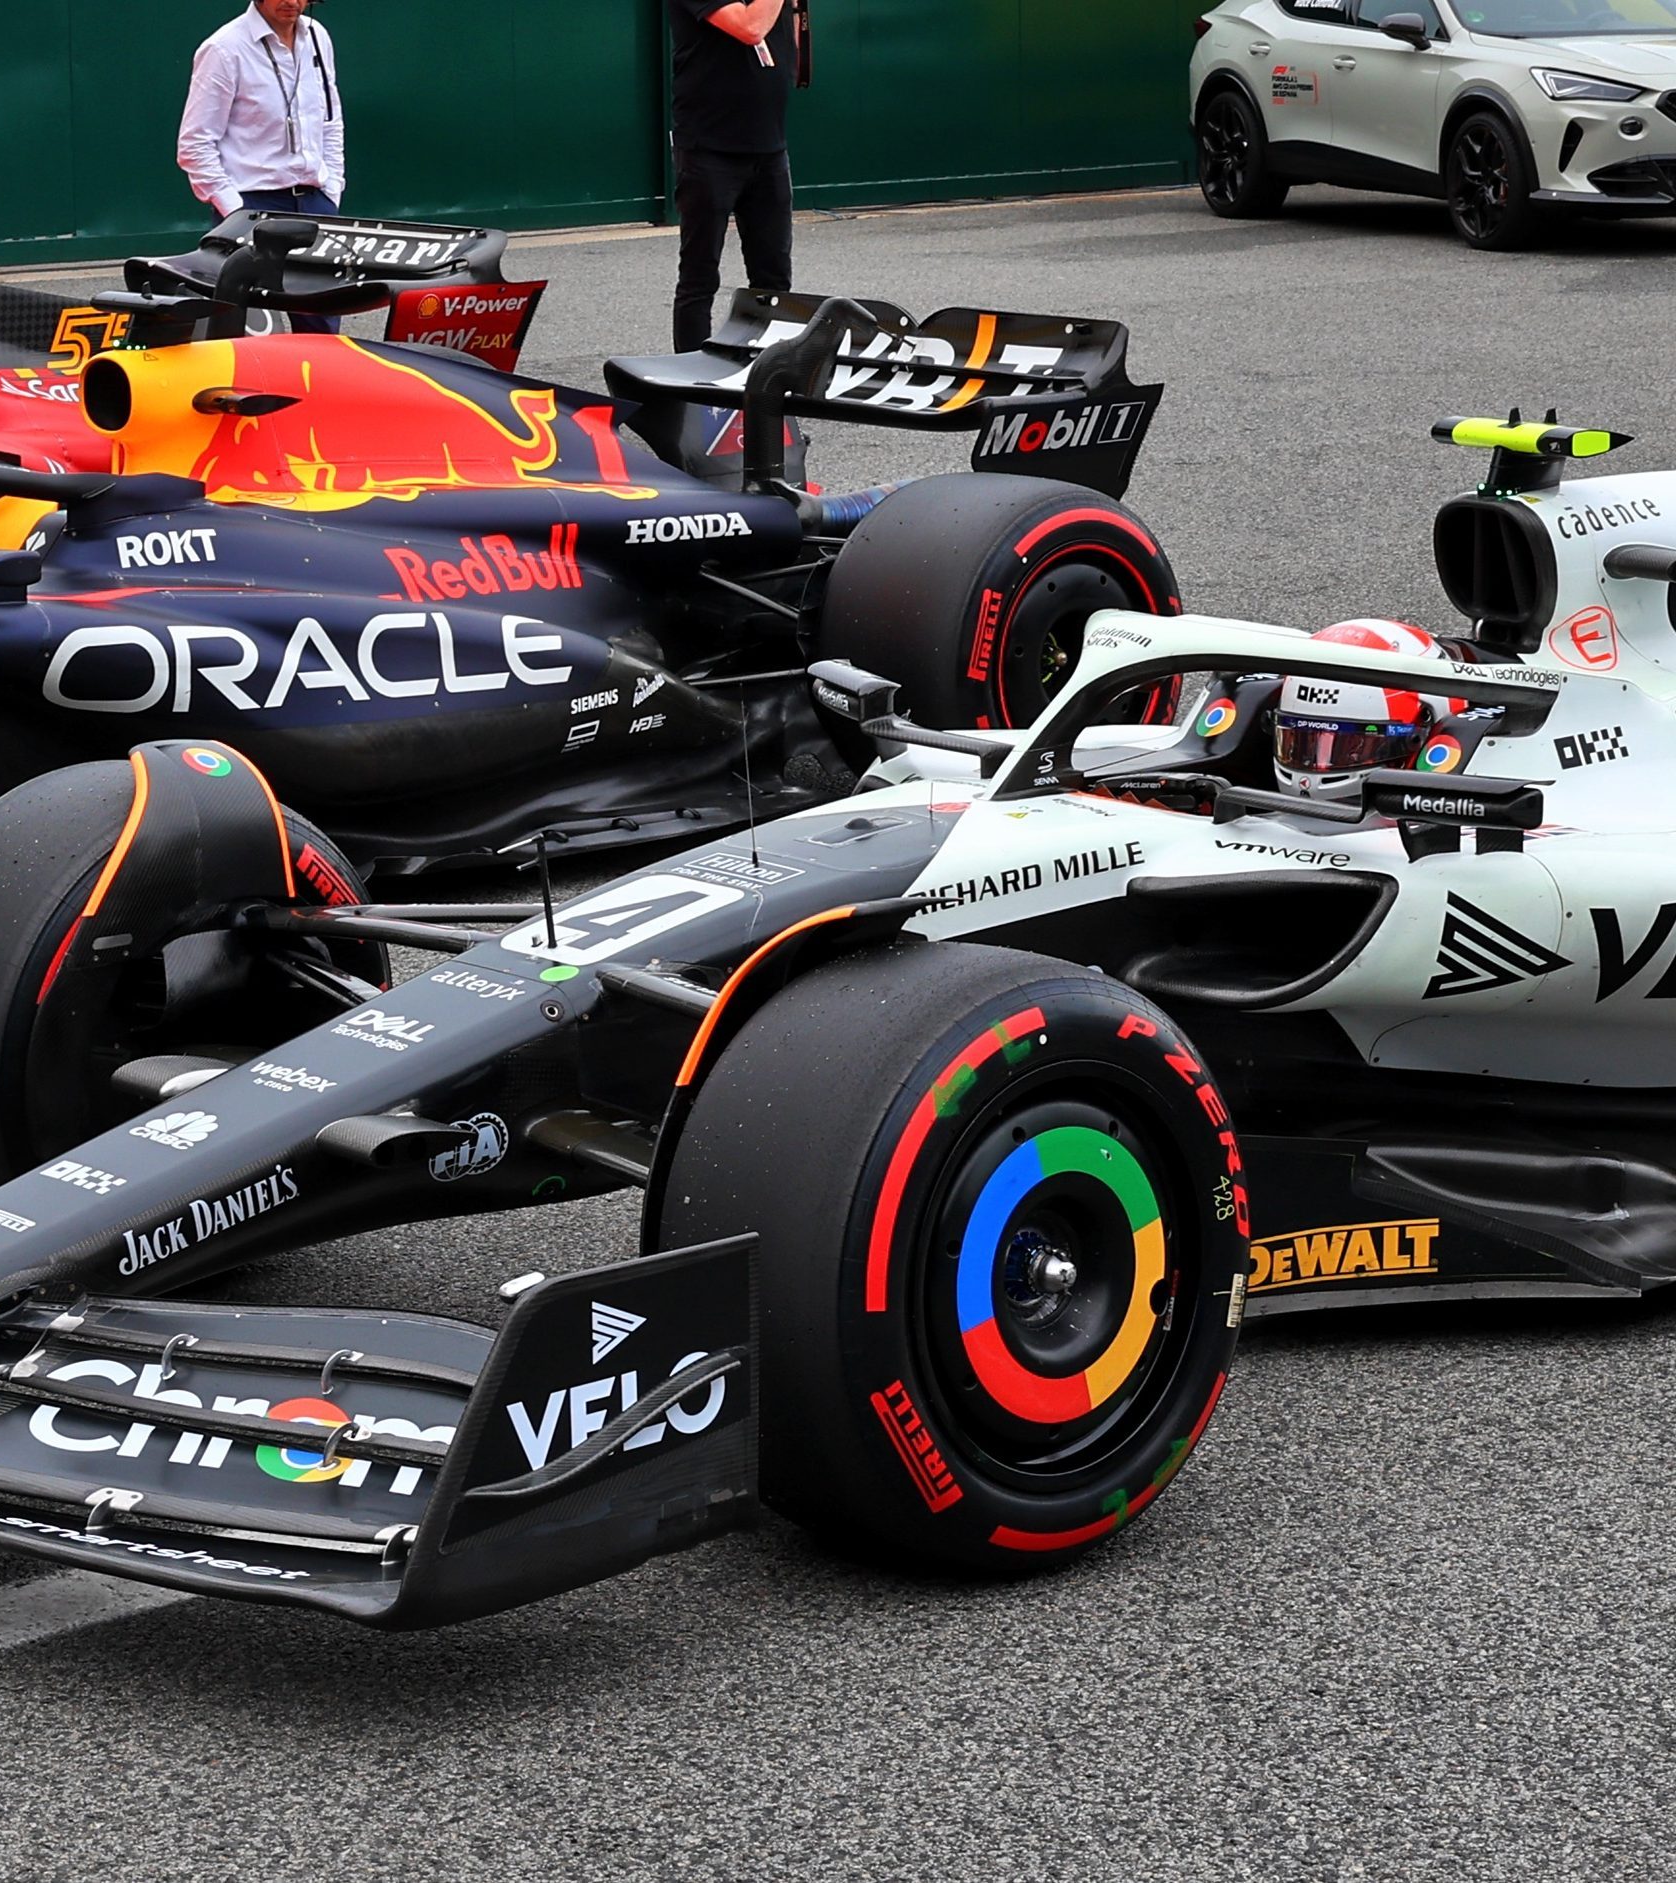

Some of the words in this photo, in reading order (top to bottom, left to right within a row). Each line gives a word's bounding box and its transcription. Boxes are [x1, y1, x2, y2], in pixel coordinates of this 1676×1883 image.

[443, 293, 528, 317] V-Power
[470, 332, 512, 349] PLAY
[980, 413, 1097, 456] Mobil
[626, 512, 752, 544] HONDA
[116, 528, 217, 568] ROKT
[967, 588, 1004, 682] PIRELLI
[43, 611, 573, 714] ORACLE
[1490, 666, 1560, 687] Technologies
[571, 688, 619, 715] SIEMENS
[1309, 721, 1339, 731] WORLD
[1403, 793, 1486, 818] Medallia
[700, 856, 783, 881] Hilton
[1053, 840, 1146, 883] MILLE
[1215, 839, 1352, 868] vmware
[671, 867, 699, 876] FOR
[700, 872, 724, 882] THE
[430, 971, 526, 1001] alteryx
[331, 1024, 408, 1051] Technologies
[345, 1009, 435, 1043] DELL
[250, 1061, 338, 1093] webex
[129, 1126, 194, 1150] CNBC
[1117, 1013, 1156, 1039] P
[1164, 1042, 1250, 1238] ZERO
[119, 1214, 188, 1276] JACK
[506, 1351, 726, 1472] VELO
[871, 1380, 964, 1512] PIRELLI
